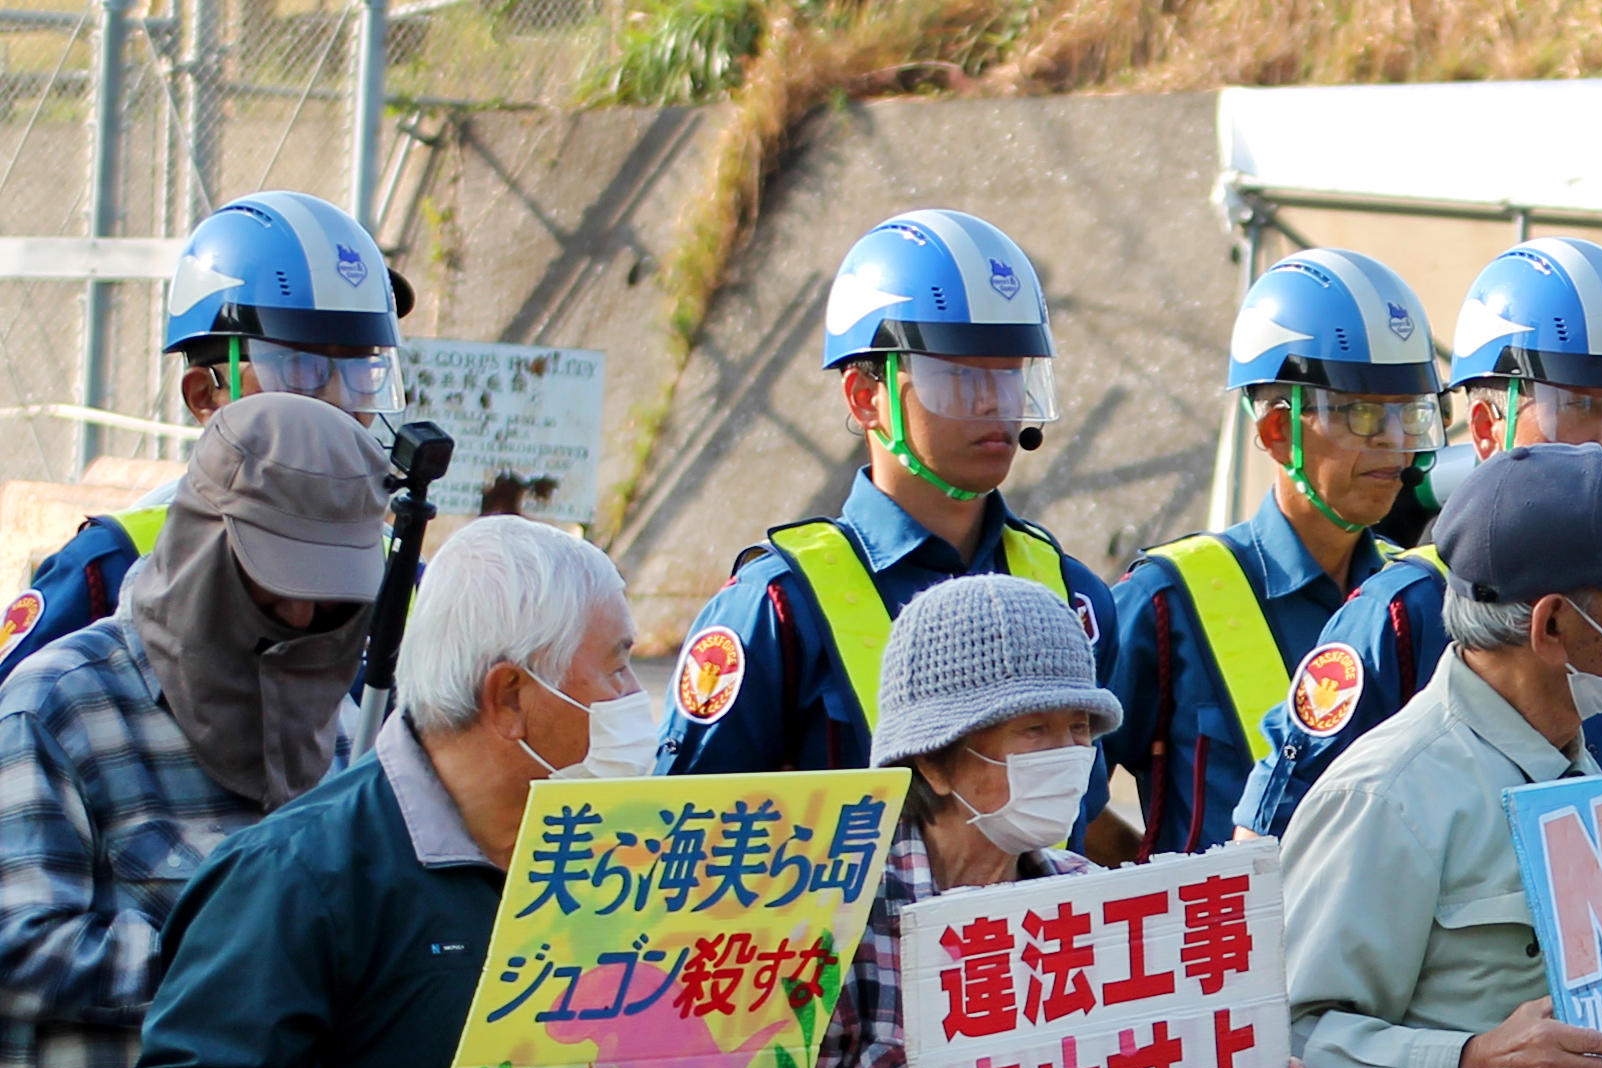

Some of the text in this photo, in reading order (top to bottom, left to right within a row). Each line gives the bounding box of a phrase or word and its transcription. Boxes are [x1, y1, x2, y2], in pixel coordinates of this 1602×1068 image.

[694, 634, 738, 666] TASKFORCE
[1311, 650, 1357, 682] TASKFORCE
[515, 795, 887, 918] 美ら海美ら島
[487, 933, 838, 1023] ジュゴン殺すな
[939, 873, 1253, 1043] 違法工事
